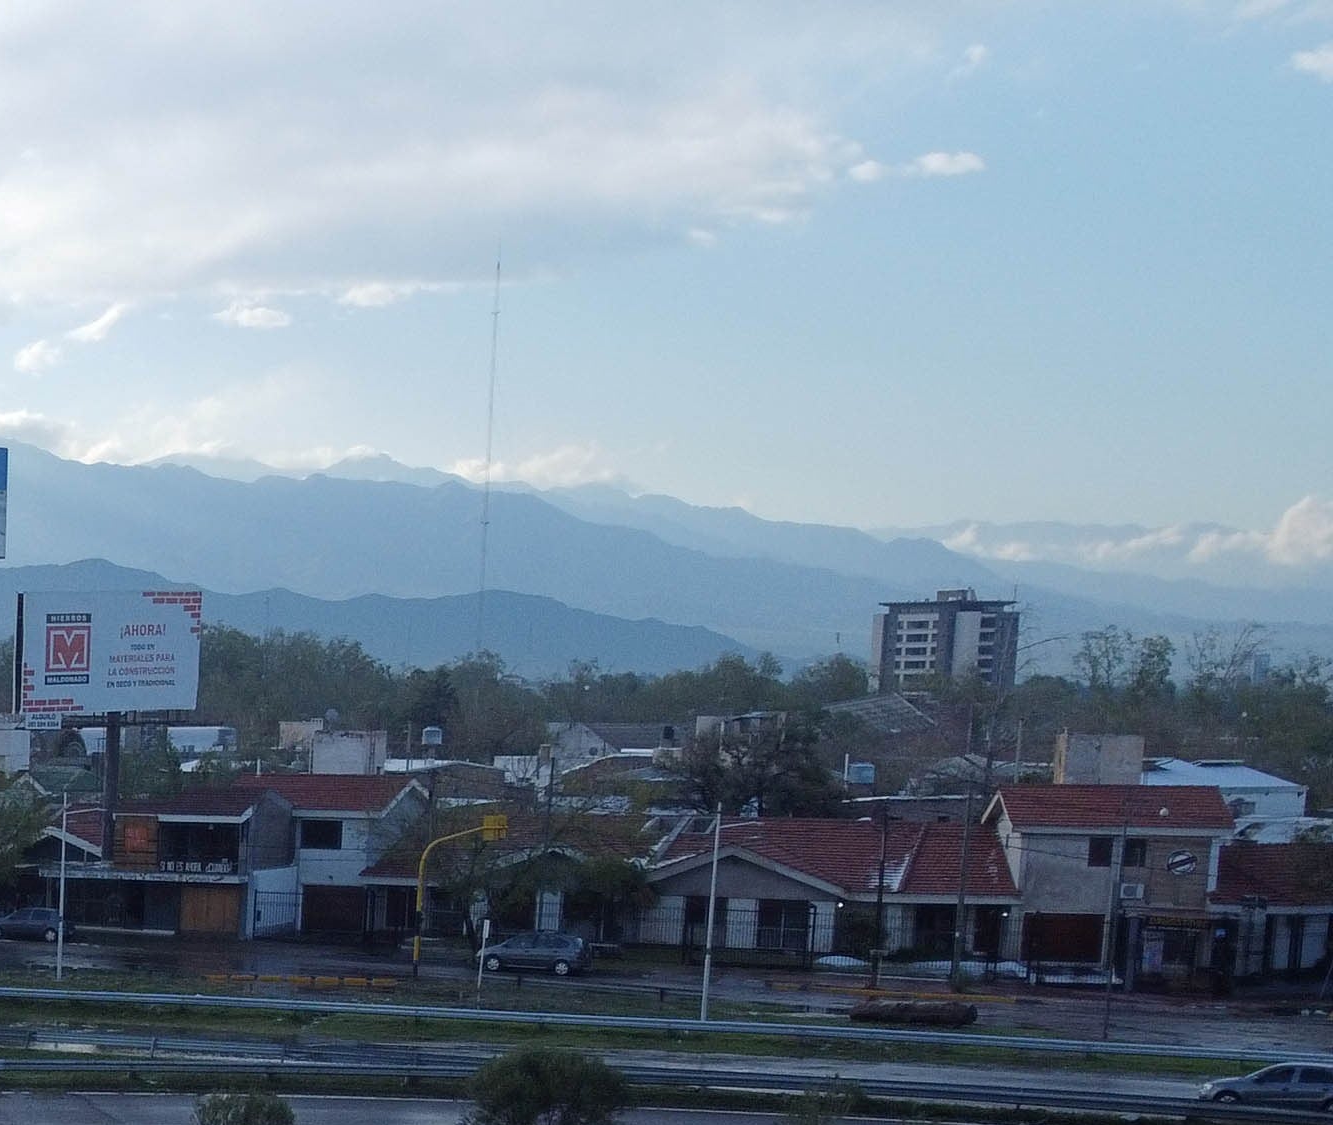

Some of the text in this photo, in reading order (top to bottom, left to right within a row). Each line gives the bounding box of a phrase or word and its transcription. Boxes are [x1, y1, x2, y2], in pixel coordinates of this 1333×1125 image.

[120, 623, 167, 640] ¡AHORA!
[109, 653, 175, 663] MATERIALES PARA
[108, 668, 117, 676] LA
